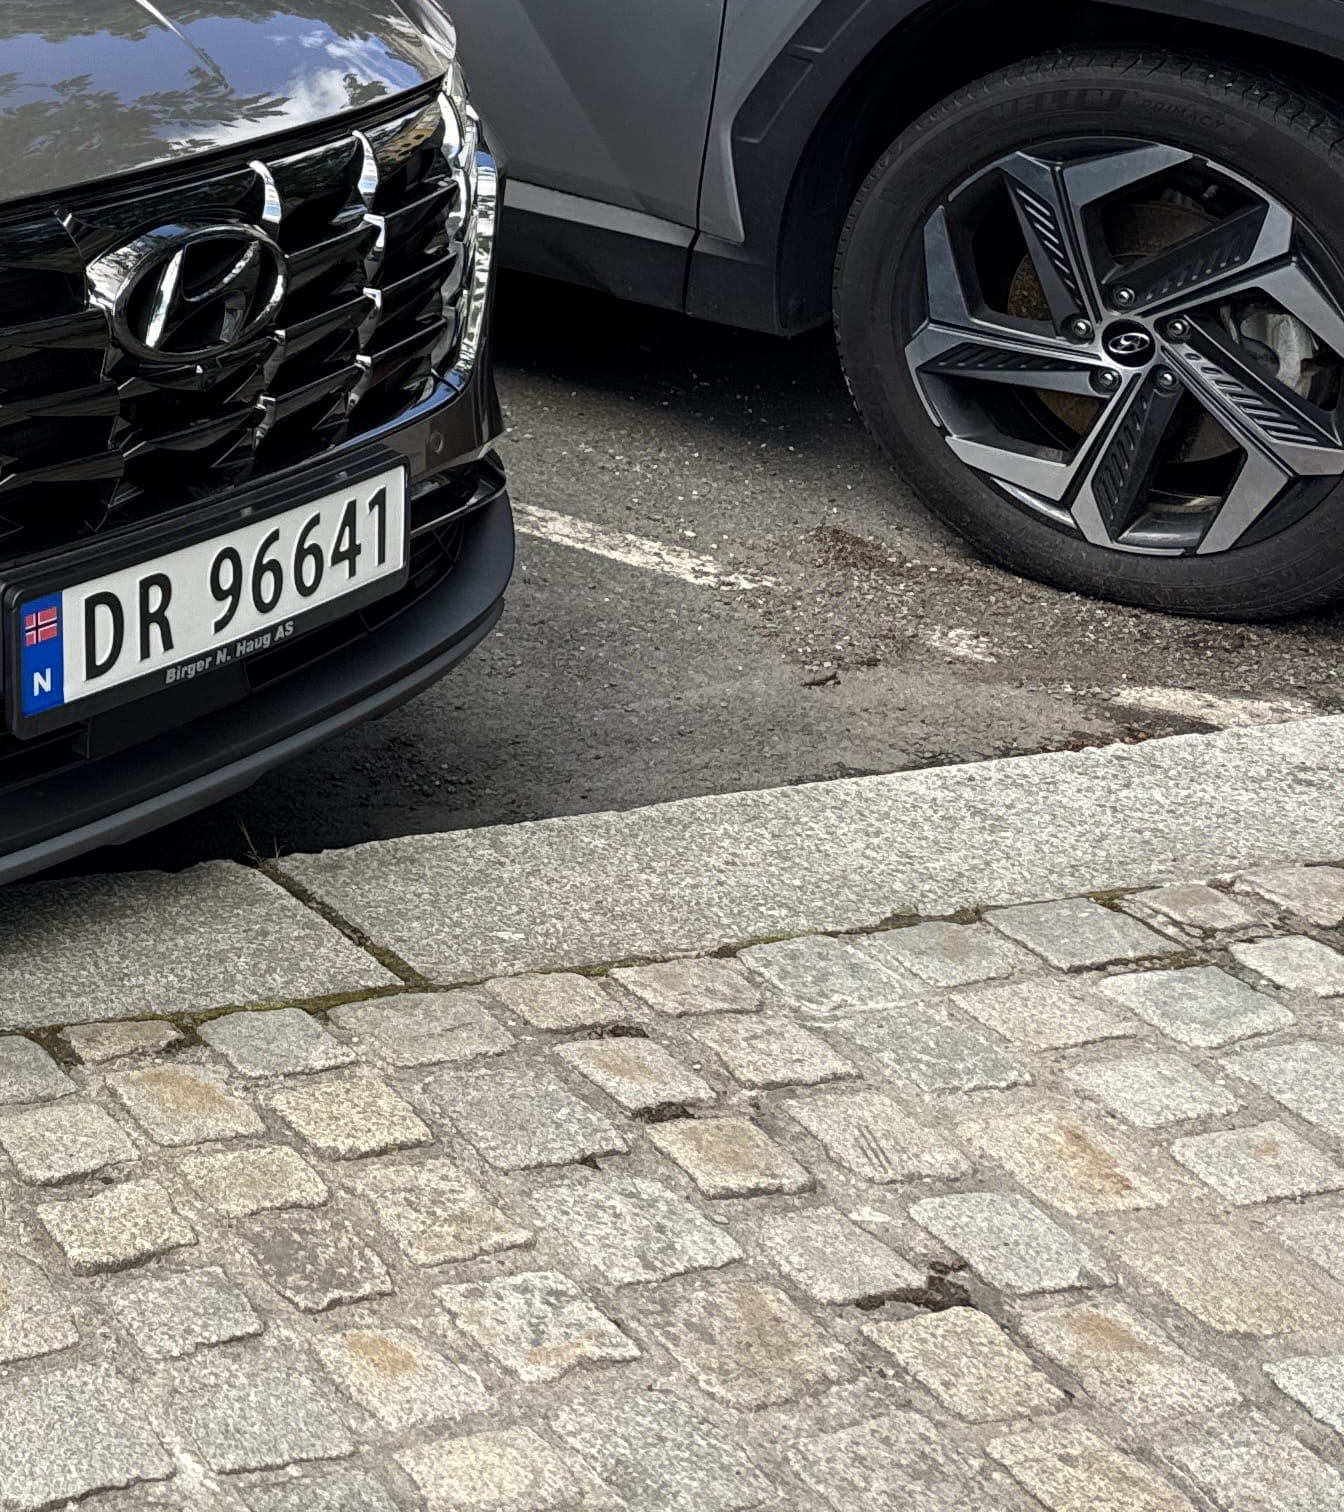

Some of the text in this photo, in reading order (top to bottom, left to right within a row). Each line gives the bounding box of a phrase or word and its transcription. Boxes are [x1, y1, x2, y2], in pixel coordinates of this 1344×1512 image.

[84, 485, 386, 682] DR 96641
[33, 667, 52, 697] N
[166, 621, 294, 684] Birger N. Haug AS
